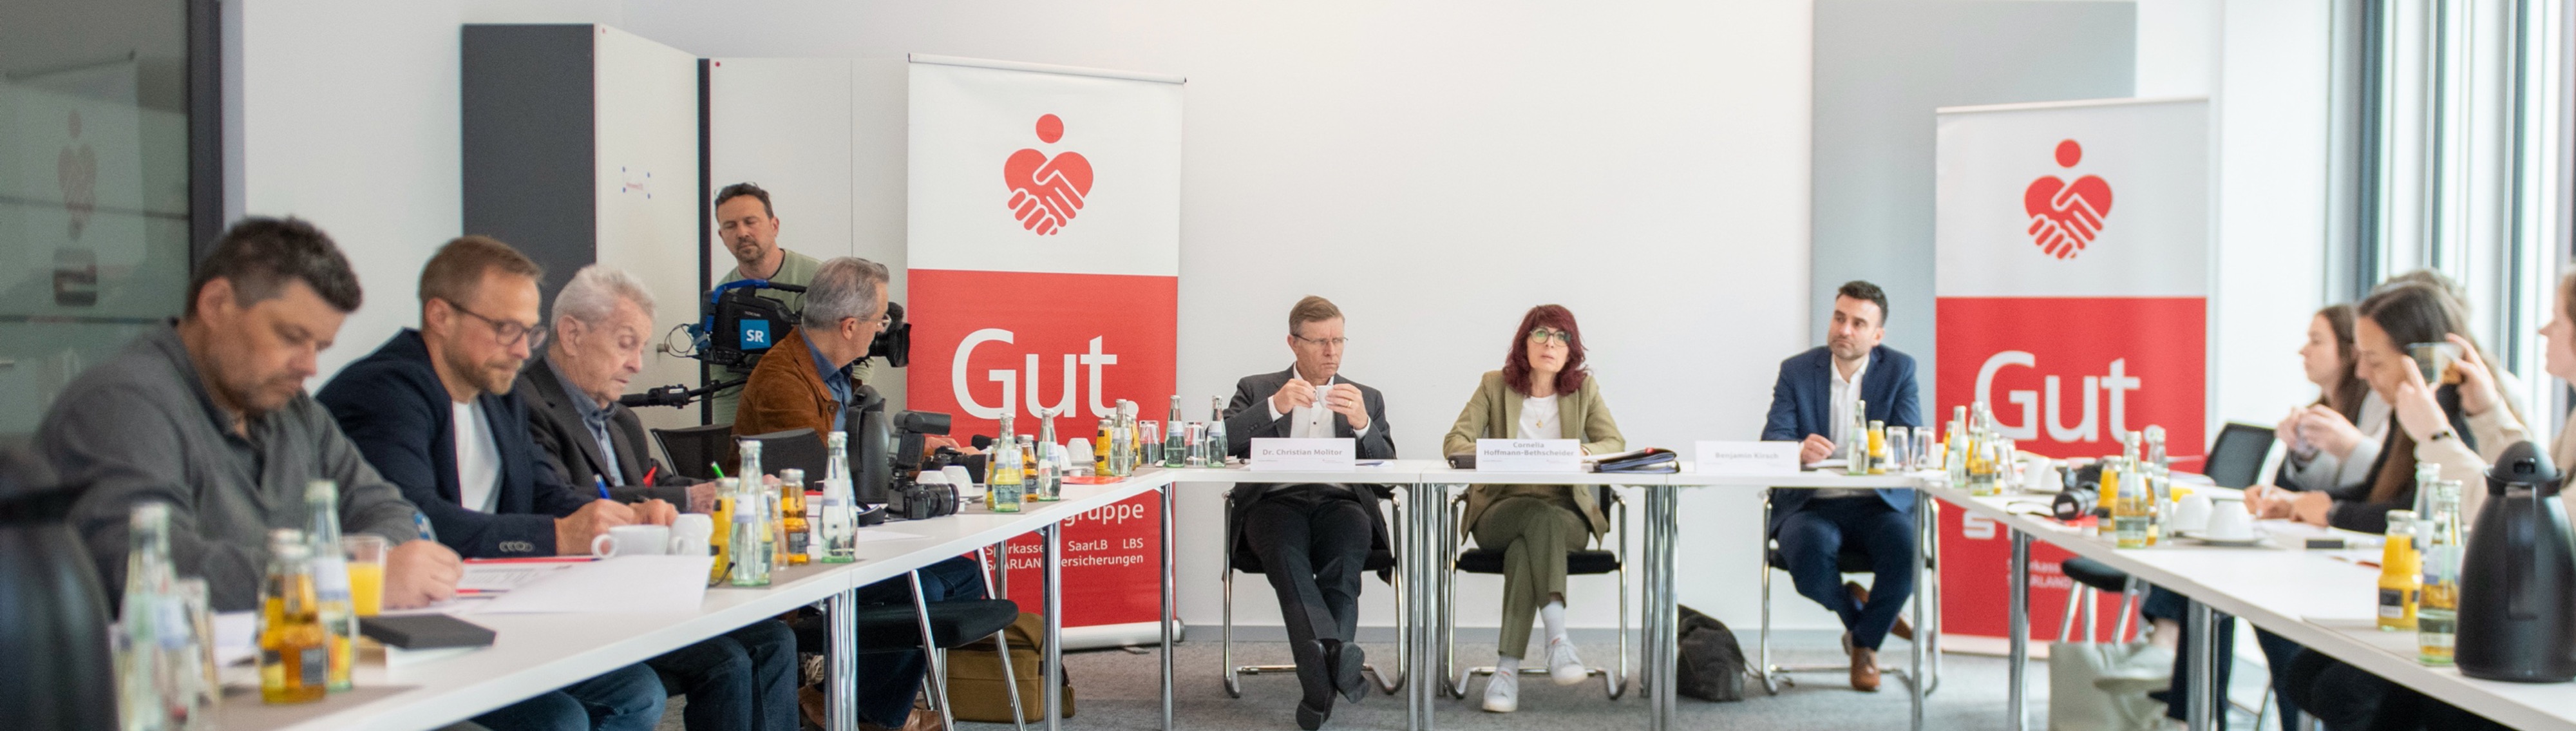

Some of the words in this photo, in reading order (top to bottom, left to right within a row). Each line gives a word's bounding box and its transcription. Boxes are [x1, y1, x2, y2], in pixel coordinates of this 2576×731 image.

[746, 329, 764, 343] SR
[952, 328, 1139, 419] Gut.
[1975, 350, 2166, 443] Gut.
[986, 543, 1043, 558] Srkasse
[1068, 539, 1108, 551] SaarLB
[1122, 538, 1144, 549] LBS
[1061, 555, 1144, 567] ersicherungen
